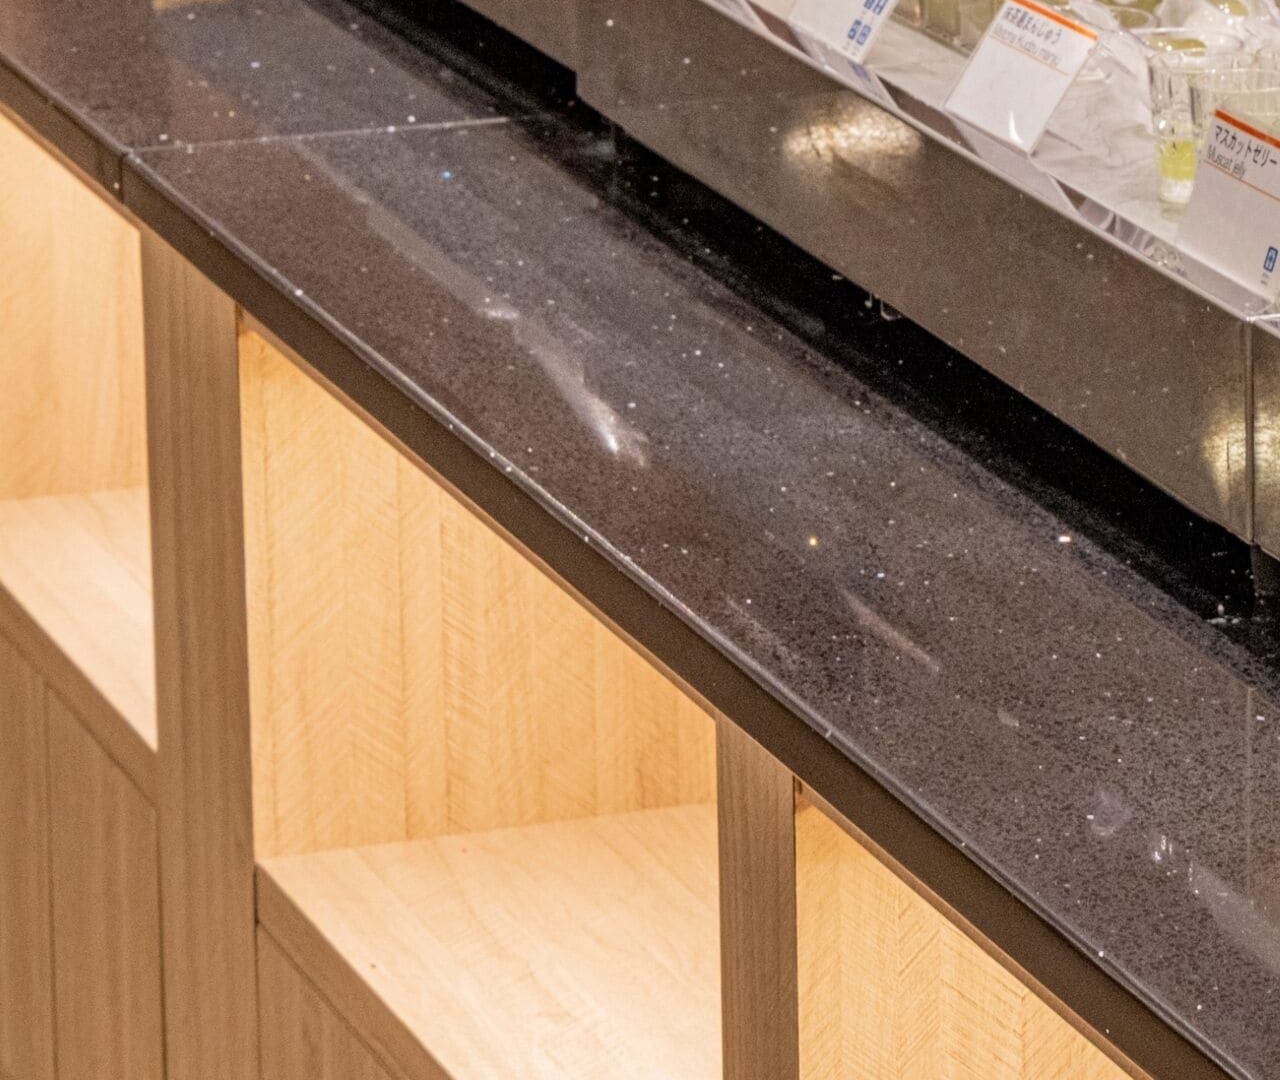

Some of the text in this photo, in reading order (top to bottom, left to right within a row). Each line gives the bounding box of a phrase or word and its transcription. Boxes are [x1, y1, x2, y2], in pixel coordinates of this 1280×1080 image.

[1215, 124, 1278, 167] マスカットゼリー
